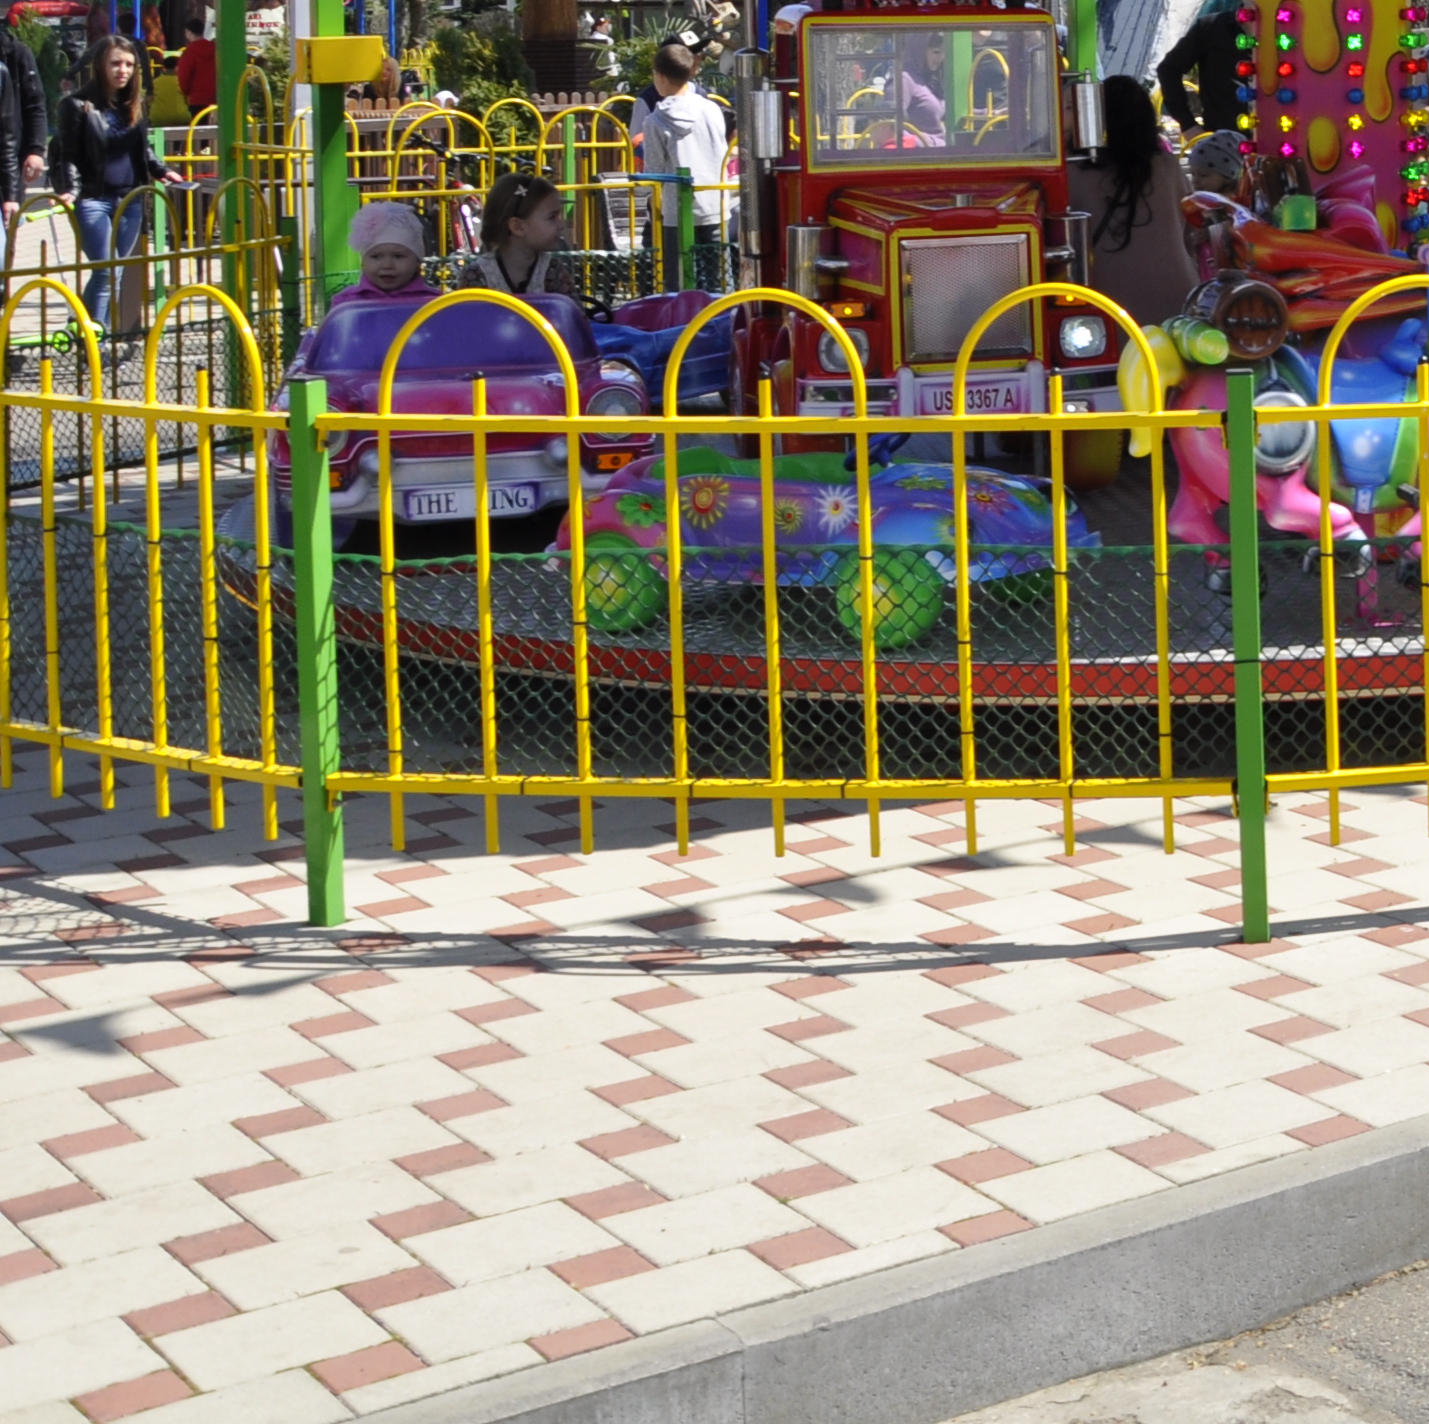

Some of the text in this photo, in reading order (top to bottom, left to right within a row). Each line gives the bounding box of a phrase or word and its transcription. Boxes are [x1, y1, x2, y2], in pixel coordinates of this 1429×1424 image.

[967, 387, 1000, 410] 3367
[1003, 387, 1015, 408] A
[412, 487, 528, 515] THE ING
